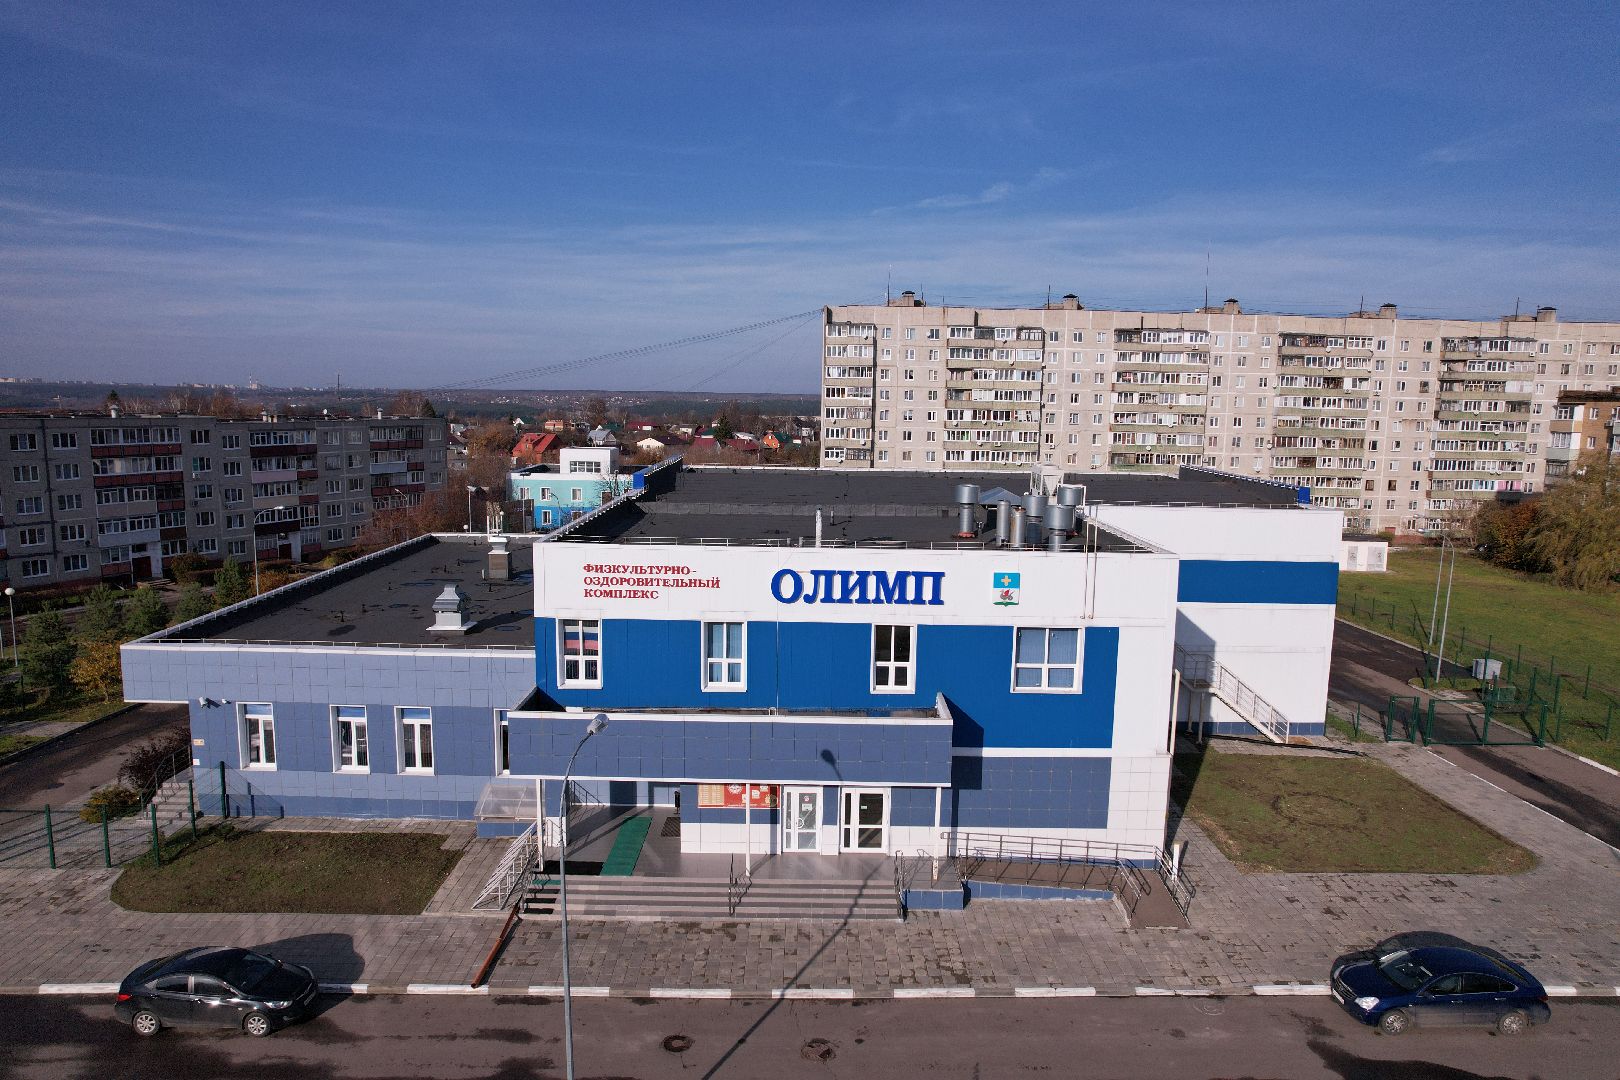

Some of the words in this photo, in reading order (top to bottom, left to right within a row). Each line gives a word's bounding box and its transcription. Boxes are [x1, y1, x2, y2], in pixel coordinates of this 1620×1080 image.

[583, 563, 697, 575] ФИЗКУЛЬТУРНО-
[583, 576, 721, 589] ОЗДОРОВИТЕЛЬНЫЙ
[771, 569, 945, 605] ОЛИМП
[583, 589, 659, 600] КОМПЛЕКС
